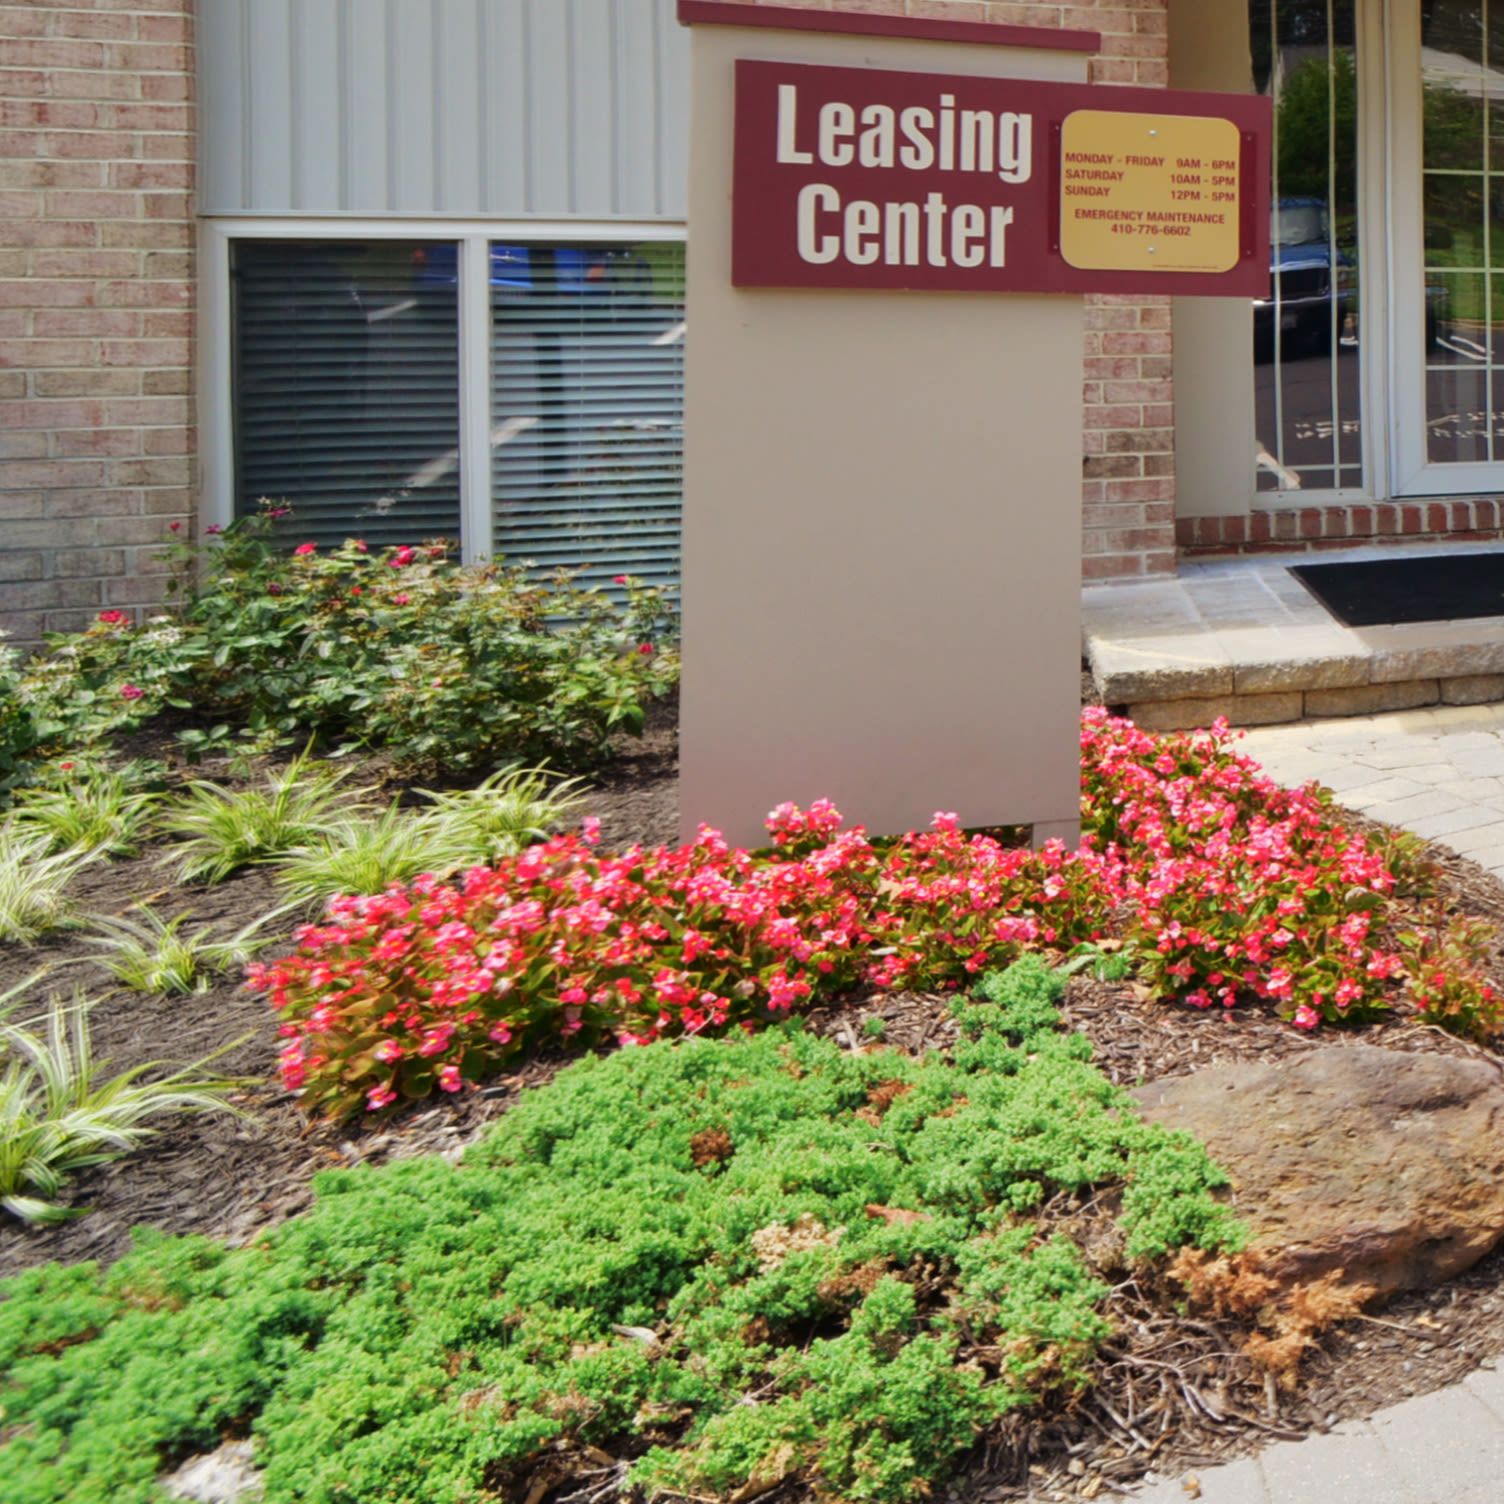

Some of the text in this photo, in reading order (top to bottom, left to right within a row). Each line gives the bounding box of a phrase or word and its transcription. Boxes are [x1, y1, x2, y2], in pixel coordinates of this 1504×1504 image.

[776, 84, 1032, 184] Leasing
[1065, 152, 1114, 165] MONDAY
[1125, 155, 1165, 167] FRIDAY
[1176, 158, 1200, 169] 9AM
[1211, 160, 1236, 170] 6PM
[1065, 169, 1124, 181] SATURDAY
[1170, 174, 1200, 185] 10AM
[1211, 176, 1236, 186] 5PM
[1065, 185, 1110, 197] SUNDAY
[1170, 190, 1200, 201] 12PM
[1211, 192, 1236, 202] 5PM
[1075, 208, 1225, 224] EMERGENCY MAINTENANCE
[797, 183, 1014, 269] Center
[1111, 224, 1191, 236] 410-776-6602
